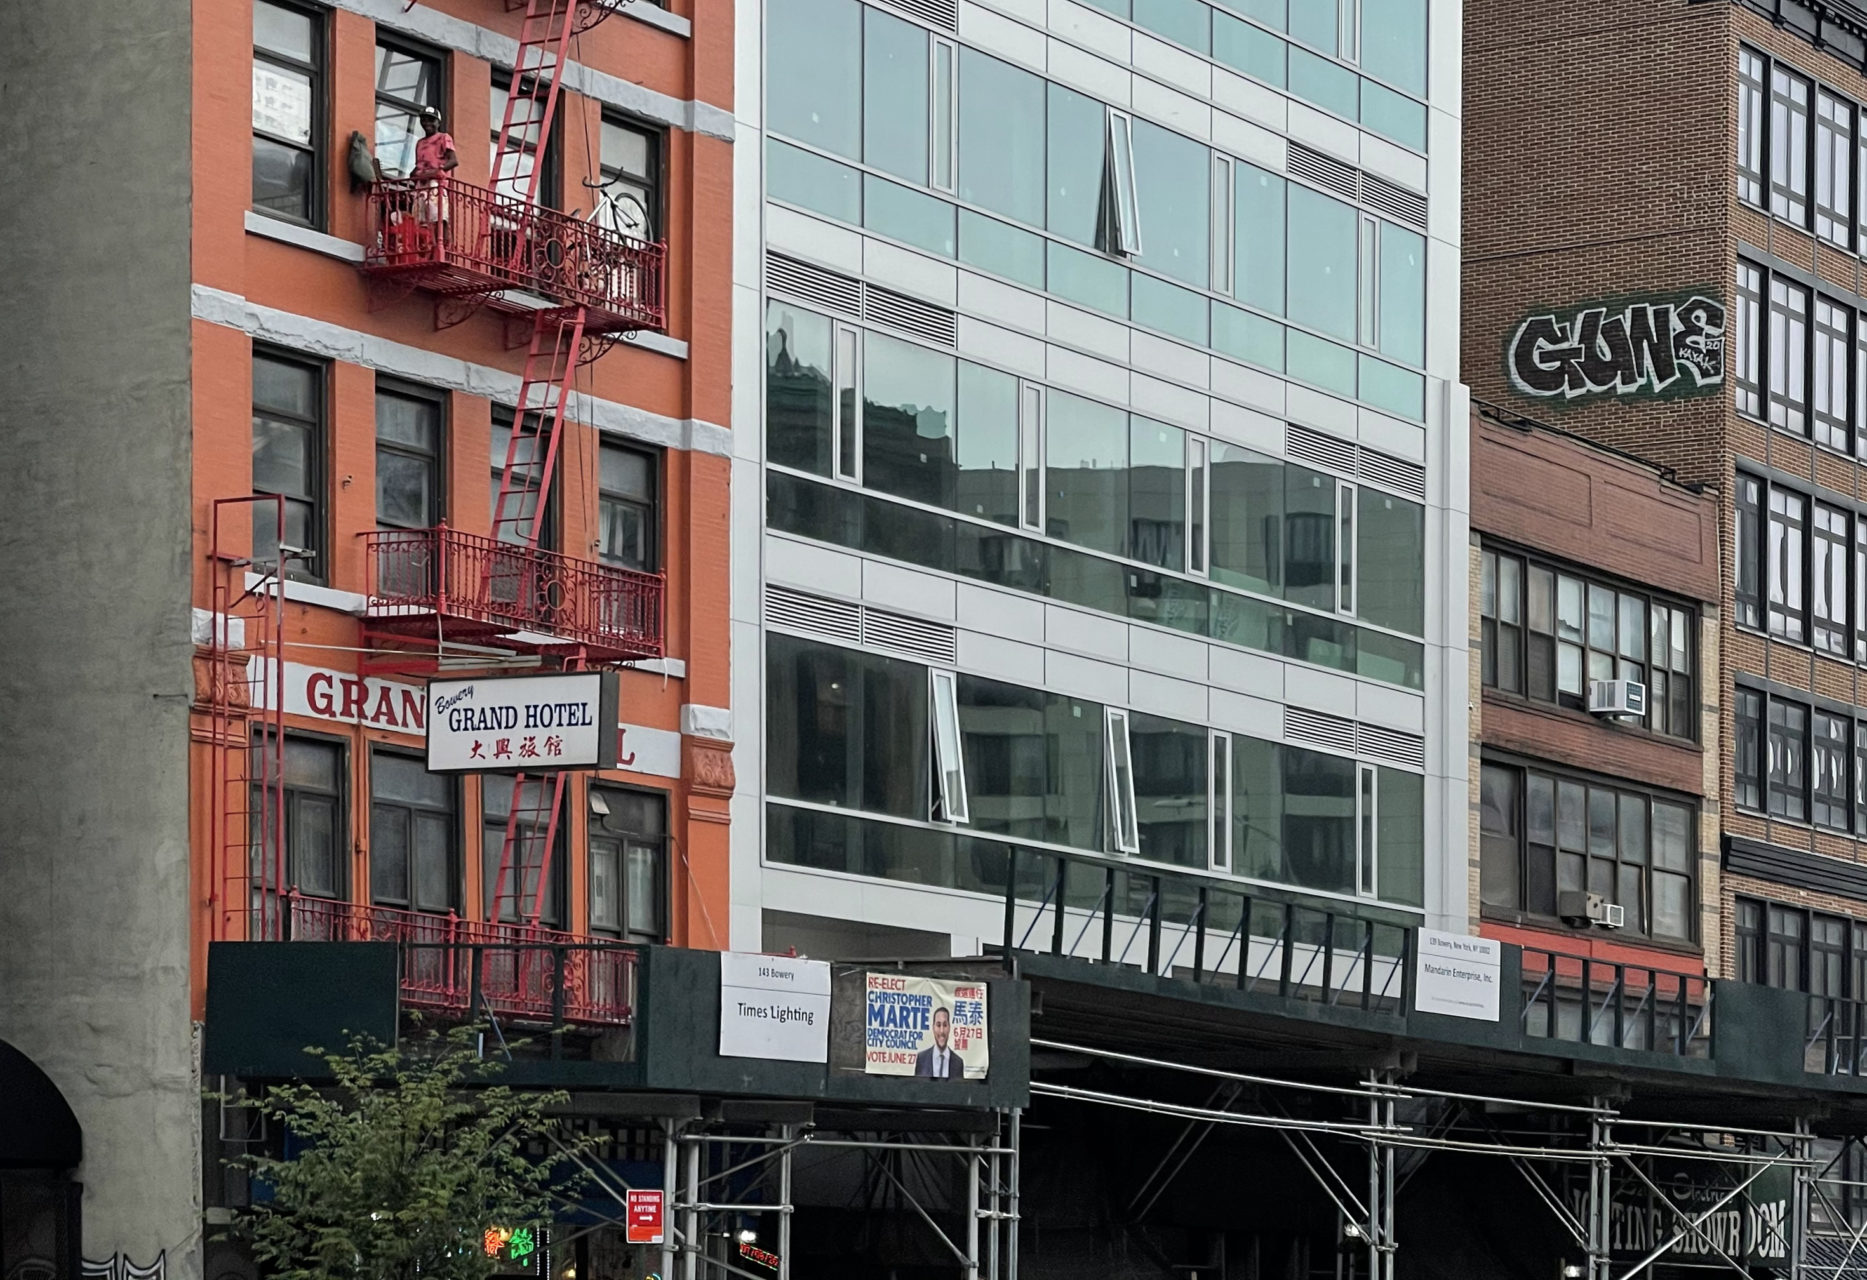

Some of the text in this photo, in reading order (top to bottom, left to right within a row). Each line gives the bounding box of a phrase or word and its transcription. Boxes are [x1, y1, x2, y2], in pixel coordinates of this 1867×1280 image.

[306, 672, 426, 729] GRAN
[434, 684, 474, 714] Bowery
[449, 702, 593, 732] GRAND HOTEL
[758, 967, 795, 981] 143 Bowery
[1424, 963, 1493, 983] Mandarin Enterprise, Inc.
[868, 976, 906, 991] RE-ELECT
[868, 990, 933, 1007] CHRISTOPHER
[737, 1002, 814, 1025] Times Lighting
[868, 1003, 930, 1031] MARTE
[867, 1028, 923, 1041] DEMOCRAT FOR
[867, 1038, 918, 1050] CITY COUNCIL
[866, 1051, 917, 1065] VOTE JUNE 27
[630, 1194, 637, 1202] NO
[633, 1205, 657, 1213] ANYTIME
